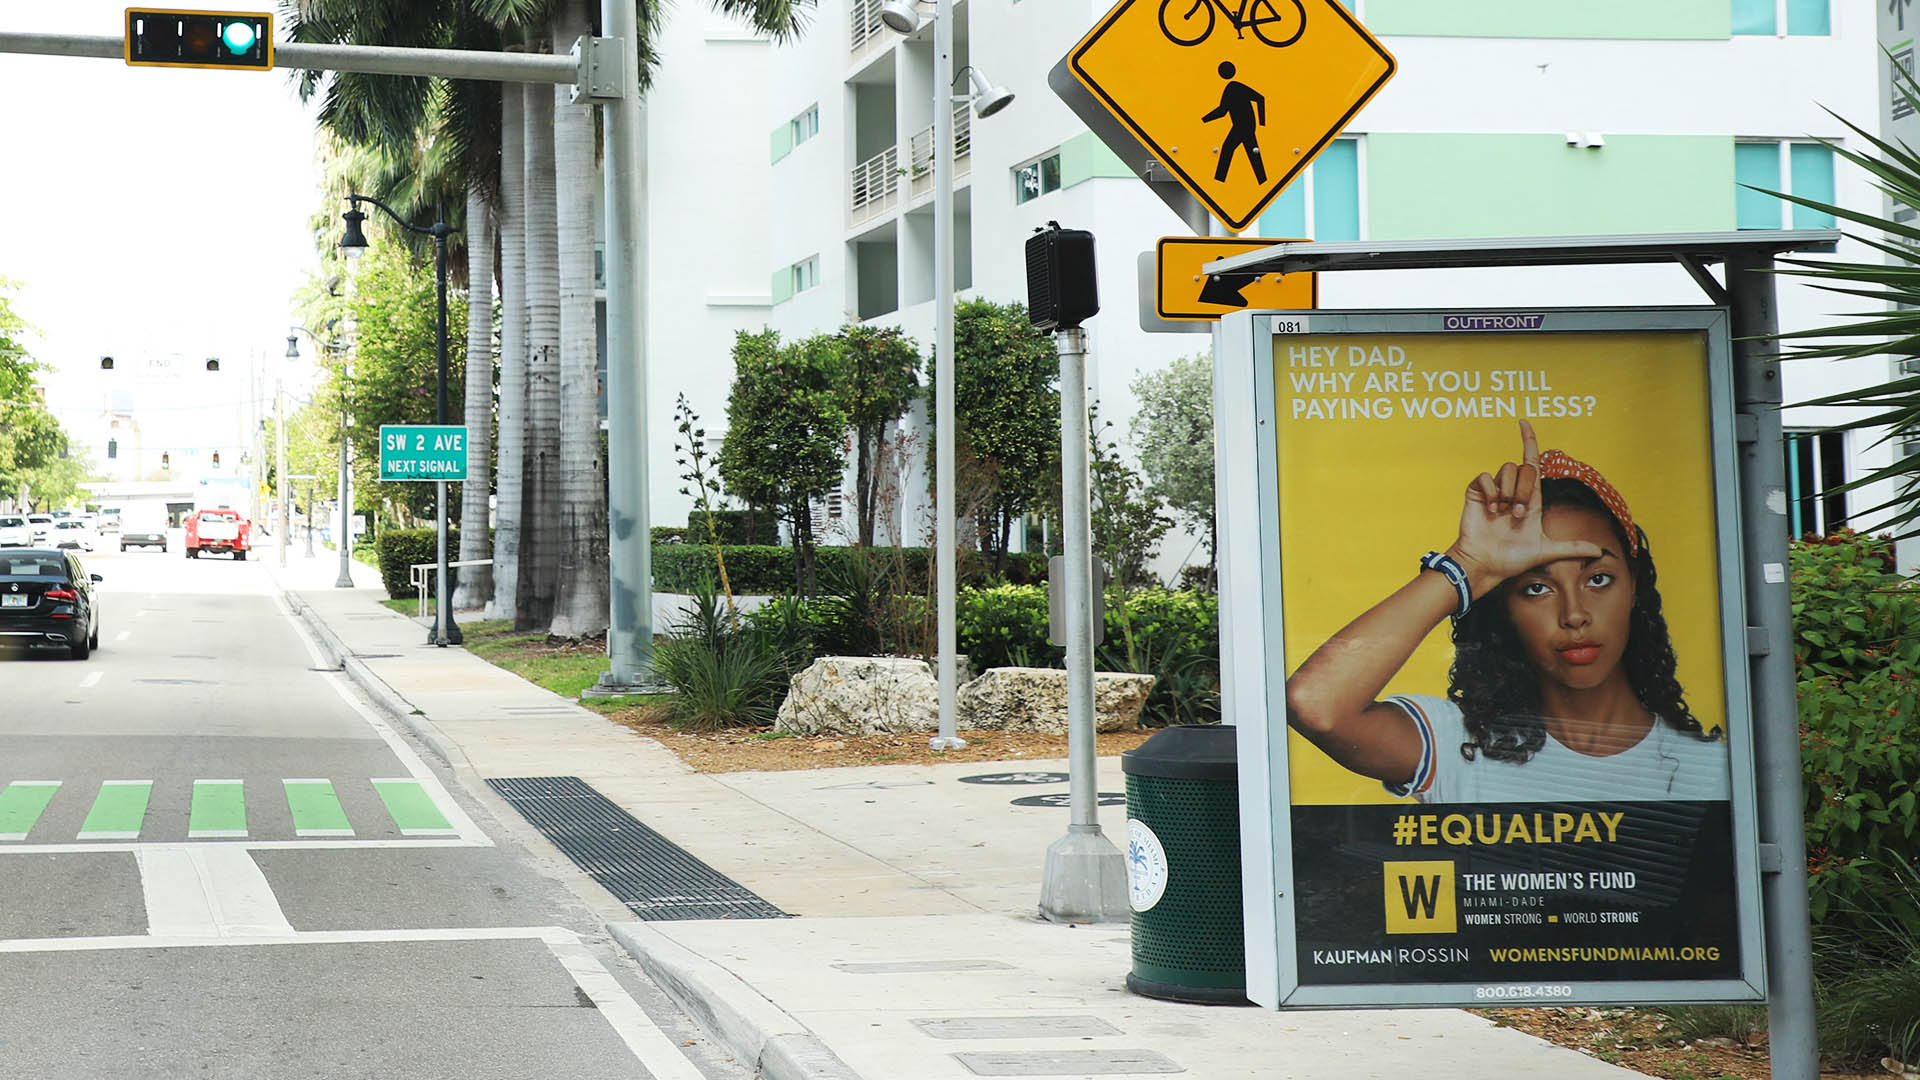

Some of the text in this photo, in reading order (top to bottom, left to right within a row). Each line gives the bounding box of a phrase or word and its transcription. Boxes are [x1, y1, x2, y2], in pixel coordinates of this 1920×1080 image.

[1278, 321, 1301, 333] 081
[1447, 316, 1539, 329] OUTFRONT
[1289, 345, 1414, 370] HEY DAD,
[1289, 370, 1552, 393] WHY ARE YOU STILL
[1292, 395, 1597, 419] PAYING WOMEN LESS?
[386, 434, 462, 451] SW 2 AVE
[388, 460, 460, 472] NEXT SIGNAL
[1393, 812, 1625, 846] #EQUALPAY
[1463, 872, 1636, 891] THE WOMEN'S FUND
[1398, 875, 1441, 920] W
[1463, 896, 1545, 907] MIAMI-DADE
[1464, 913, 1542, 925] WOMEN STRONG
[1563, 912, 1597, 924] WORLD
[1313, 948, 1469, 965] KAUFMAN ROSSIN
[1490, 946, 1721, 962] WOMENSFUNDMIAMI.ORG
[1476, 985, 1572, 999] 800.618.4380
